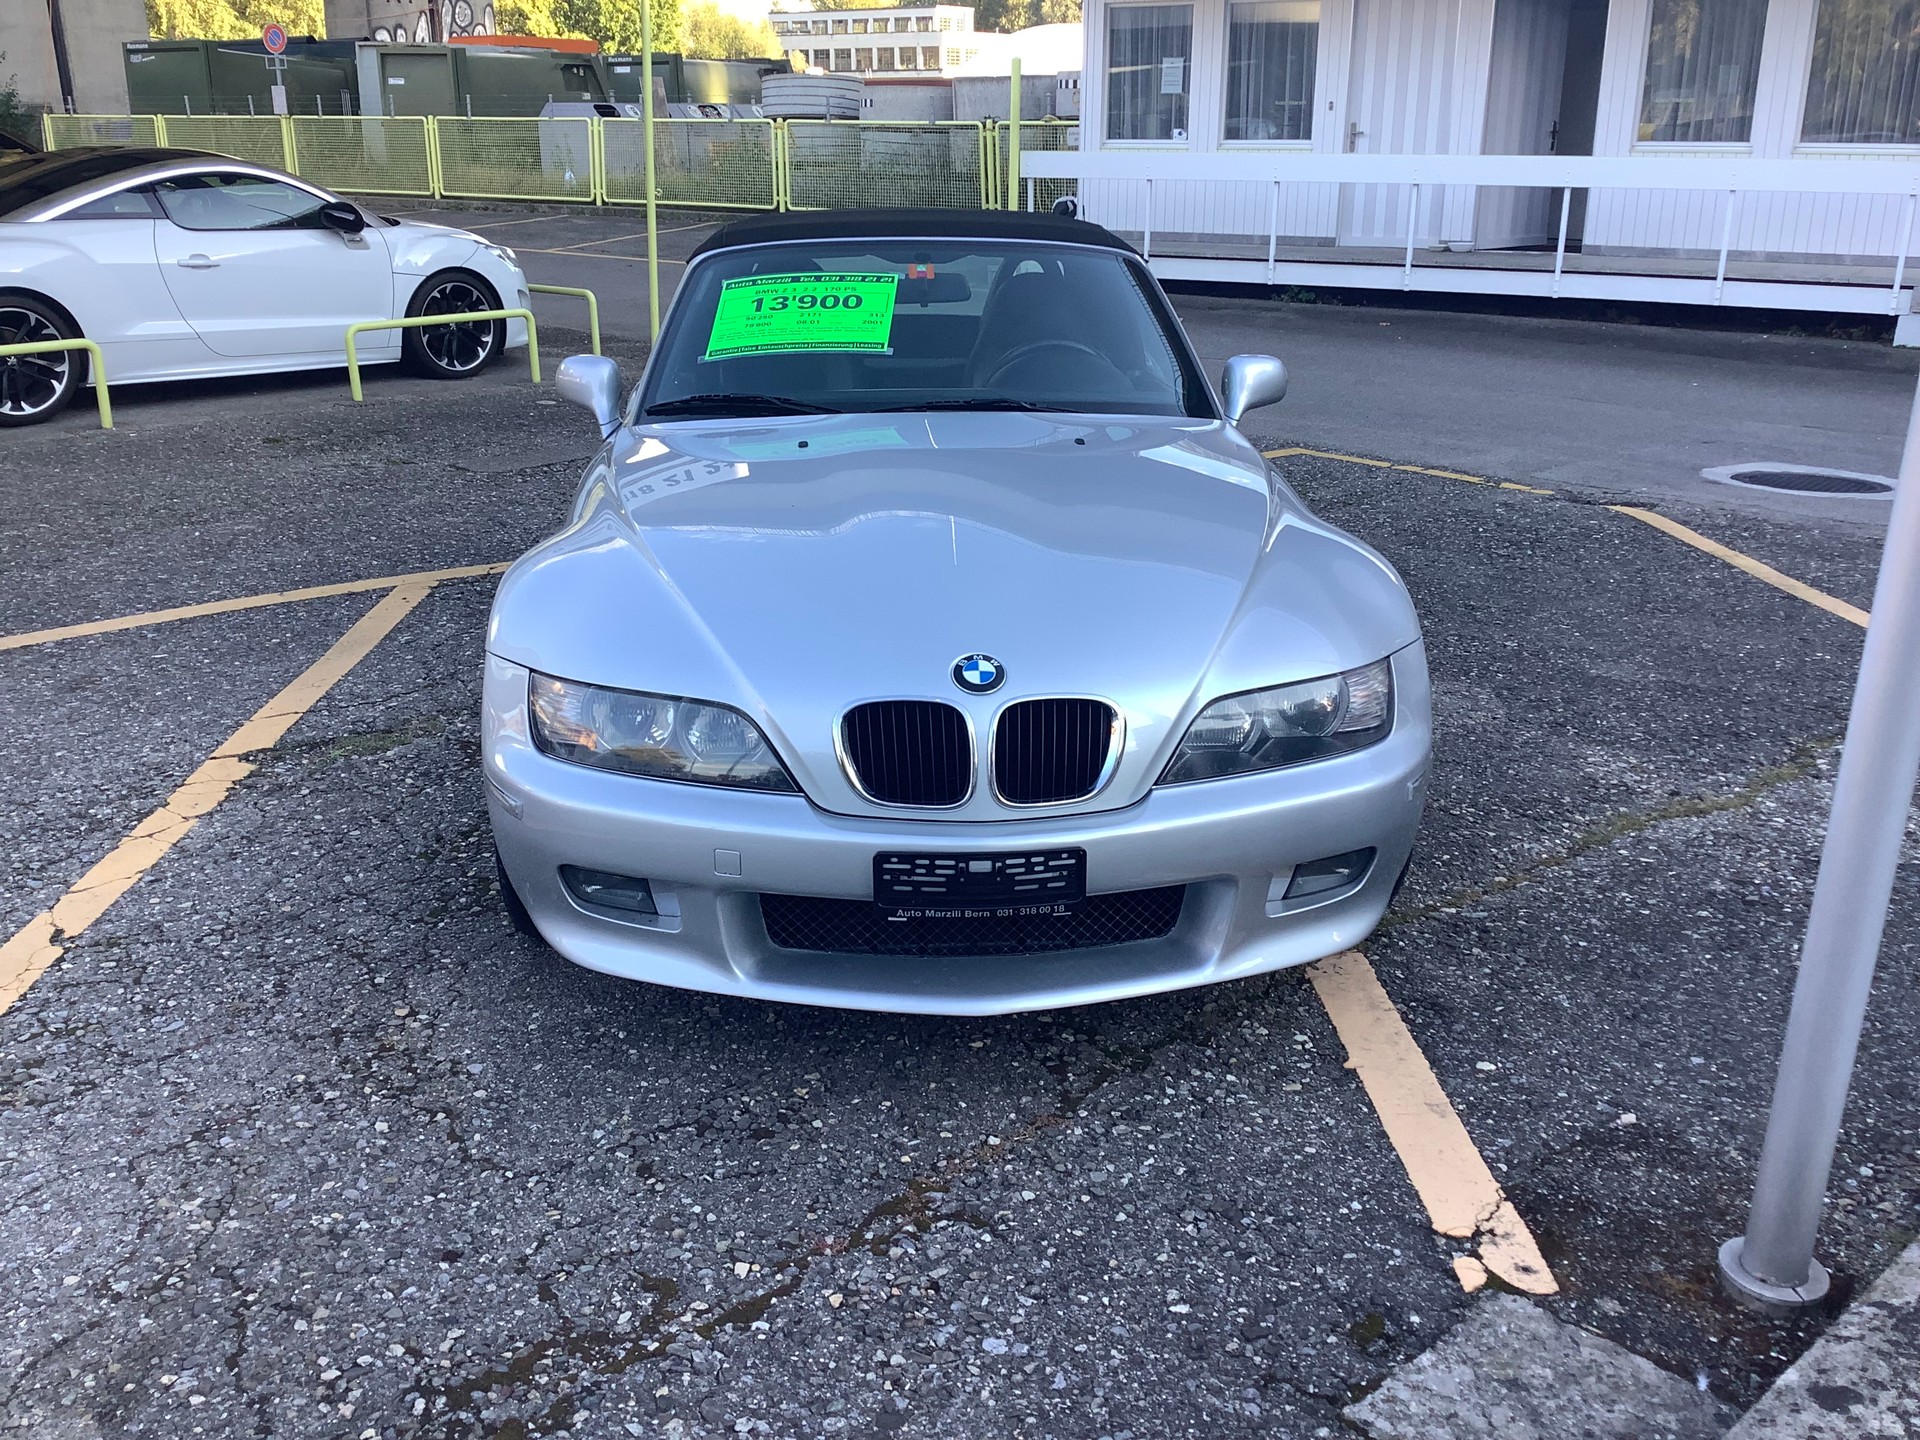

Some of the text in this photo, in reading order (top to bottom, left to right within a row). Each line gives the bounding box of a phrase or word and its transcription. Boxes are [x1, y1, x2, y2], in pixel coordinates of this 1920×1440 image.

[727, 281, 753, 289] Auto
[755, 277, 792, 285] Marzili
[751, 294, 863, 313] 13'900
[958, 654, 1001, 667] BMW
[897, 909, 922, 918] Auto
[925, 909, 961, 918] Marzili
[964, 910, 990, 918] Bern
[1039, 905, 1051, 914] 00
[1053, 904, 1065, 913] 18
